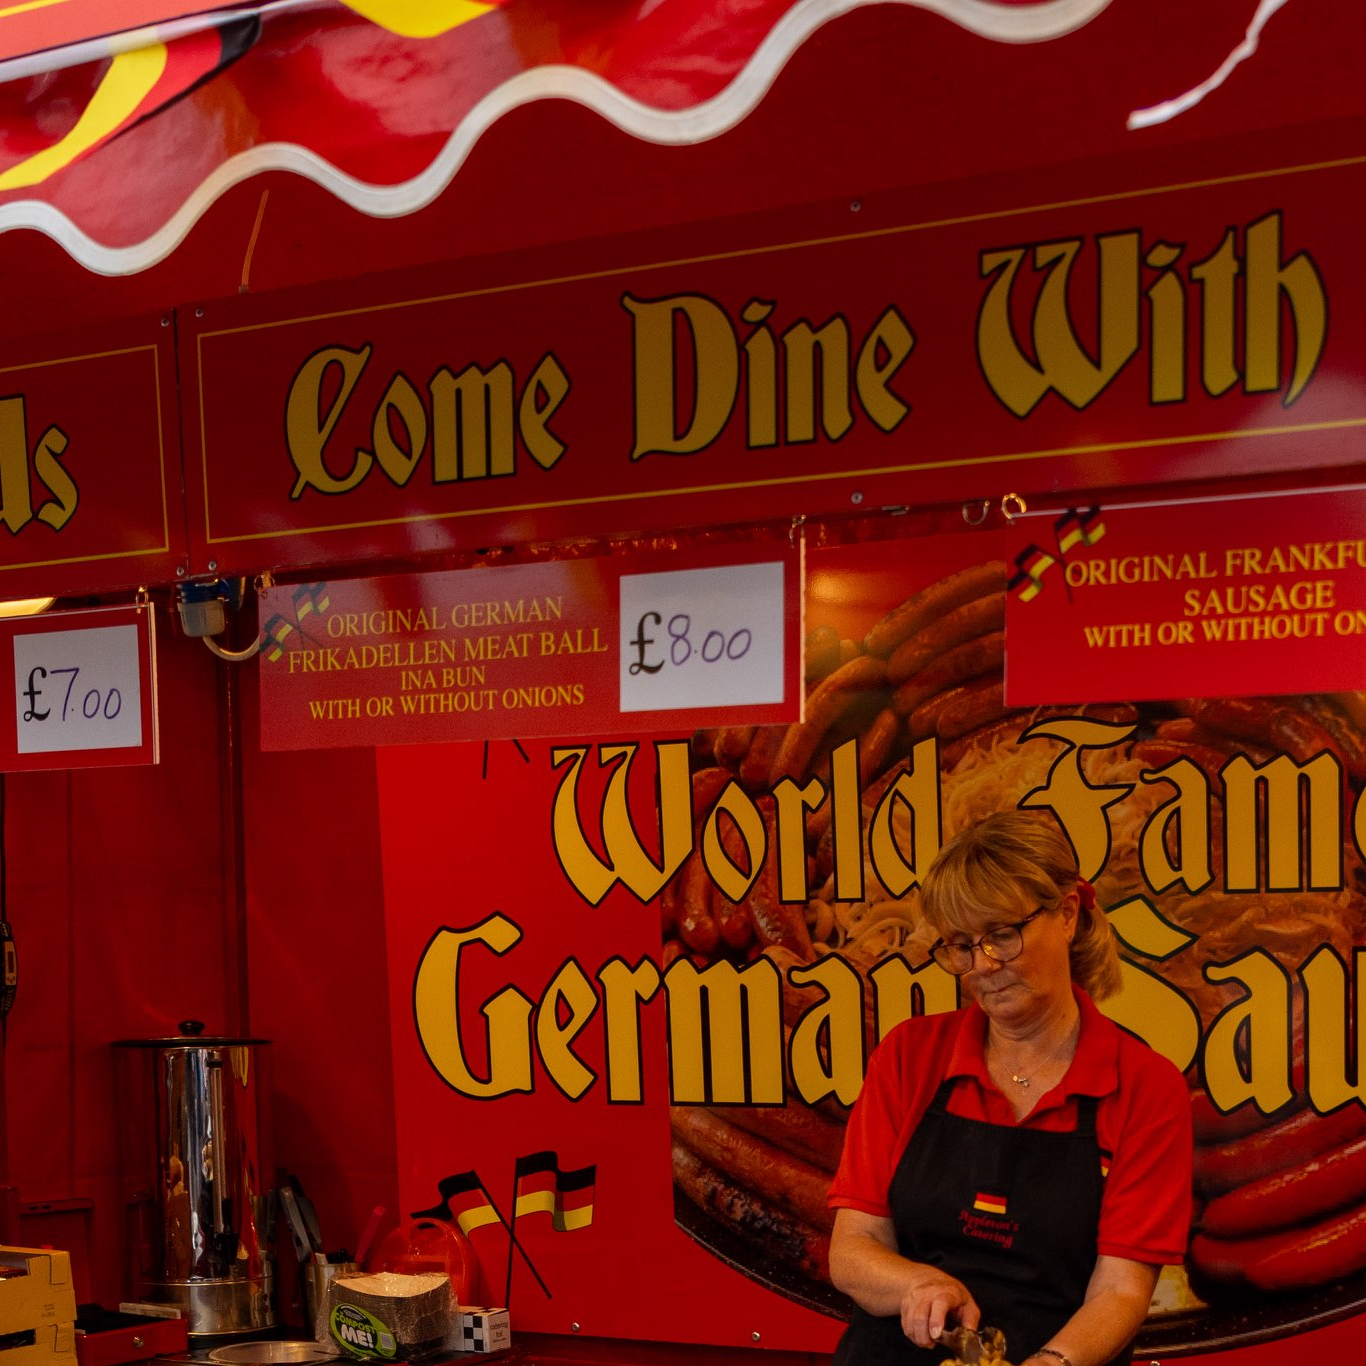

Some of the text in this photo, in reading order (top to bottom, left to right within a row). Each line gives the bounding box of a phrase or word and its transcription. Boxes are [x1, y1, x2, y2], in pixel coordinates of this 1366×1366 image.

[285, 342, 569, 500] Come
[621, 290, 917, 460] Dine
[975, 210, 1330, 420] With
[1064, 550, 1218, 589] ORIGINAL
[326, 595, 563, 638] ORIGINAL GERMAN
[1182, 580, 1337, 617] SAUSAGE
[288, 627, 609, 673] FRIKADELLEN MEAT BALL
[628, 611, 753, 677] £8.00
[1083, 622, 1152, 650] WITH
[1156, 620, 1195, 646] OR
[1200, 612, 1330, 645] WITHOUT
[22, 666, 122, 722] £7.00
[441, 666, 487, 688] BUN
[308, 683, 585, 720] WITH OR WITHOUT ONIONS
[549, 738, 942, 907] World
[335, 1311, 376, 1335] COMPOST
[340, 1322, 374, 1349] ME!
